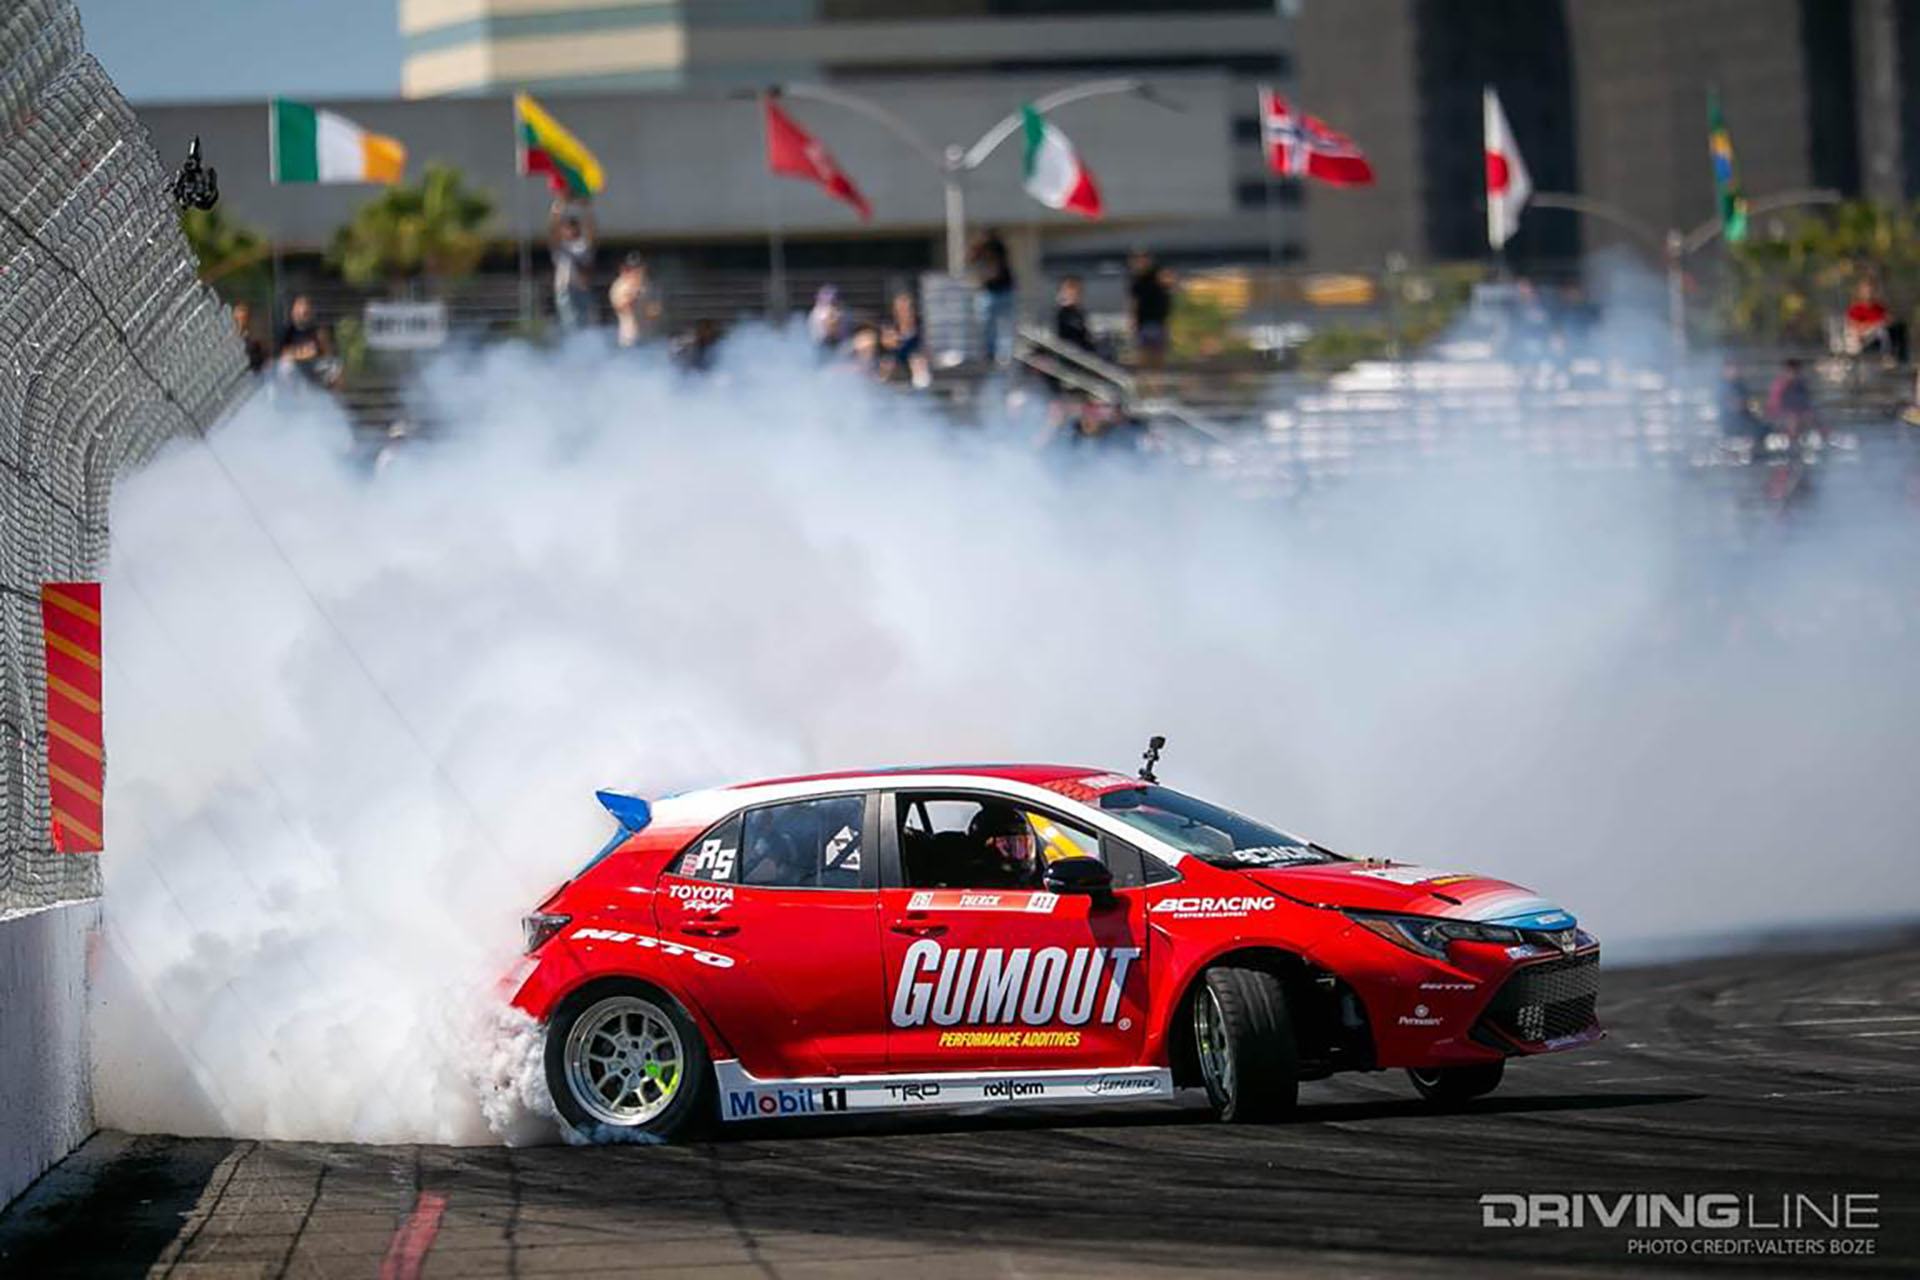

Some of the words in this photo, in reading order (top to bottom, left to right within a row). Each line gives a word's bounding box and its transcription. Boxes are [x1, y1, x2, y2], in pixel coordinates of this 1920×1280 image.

[695, 838, 738, 880] RS
[669, 885, 735, 901] TOYOTA
[569, 927, 736, 968] NITTO
[890, 939, 1142, 1028] GUMOUT
[938, 1032, 1021, 1048] PERFORMANCE
[1021, 1031, 1081, 1047] ADDITIVES
[729, 1087, 815, 1117] Mobil
[884, 1082, 940, 1101] TRD
[983, 1080, 1045, 1100] rotiform
